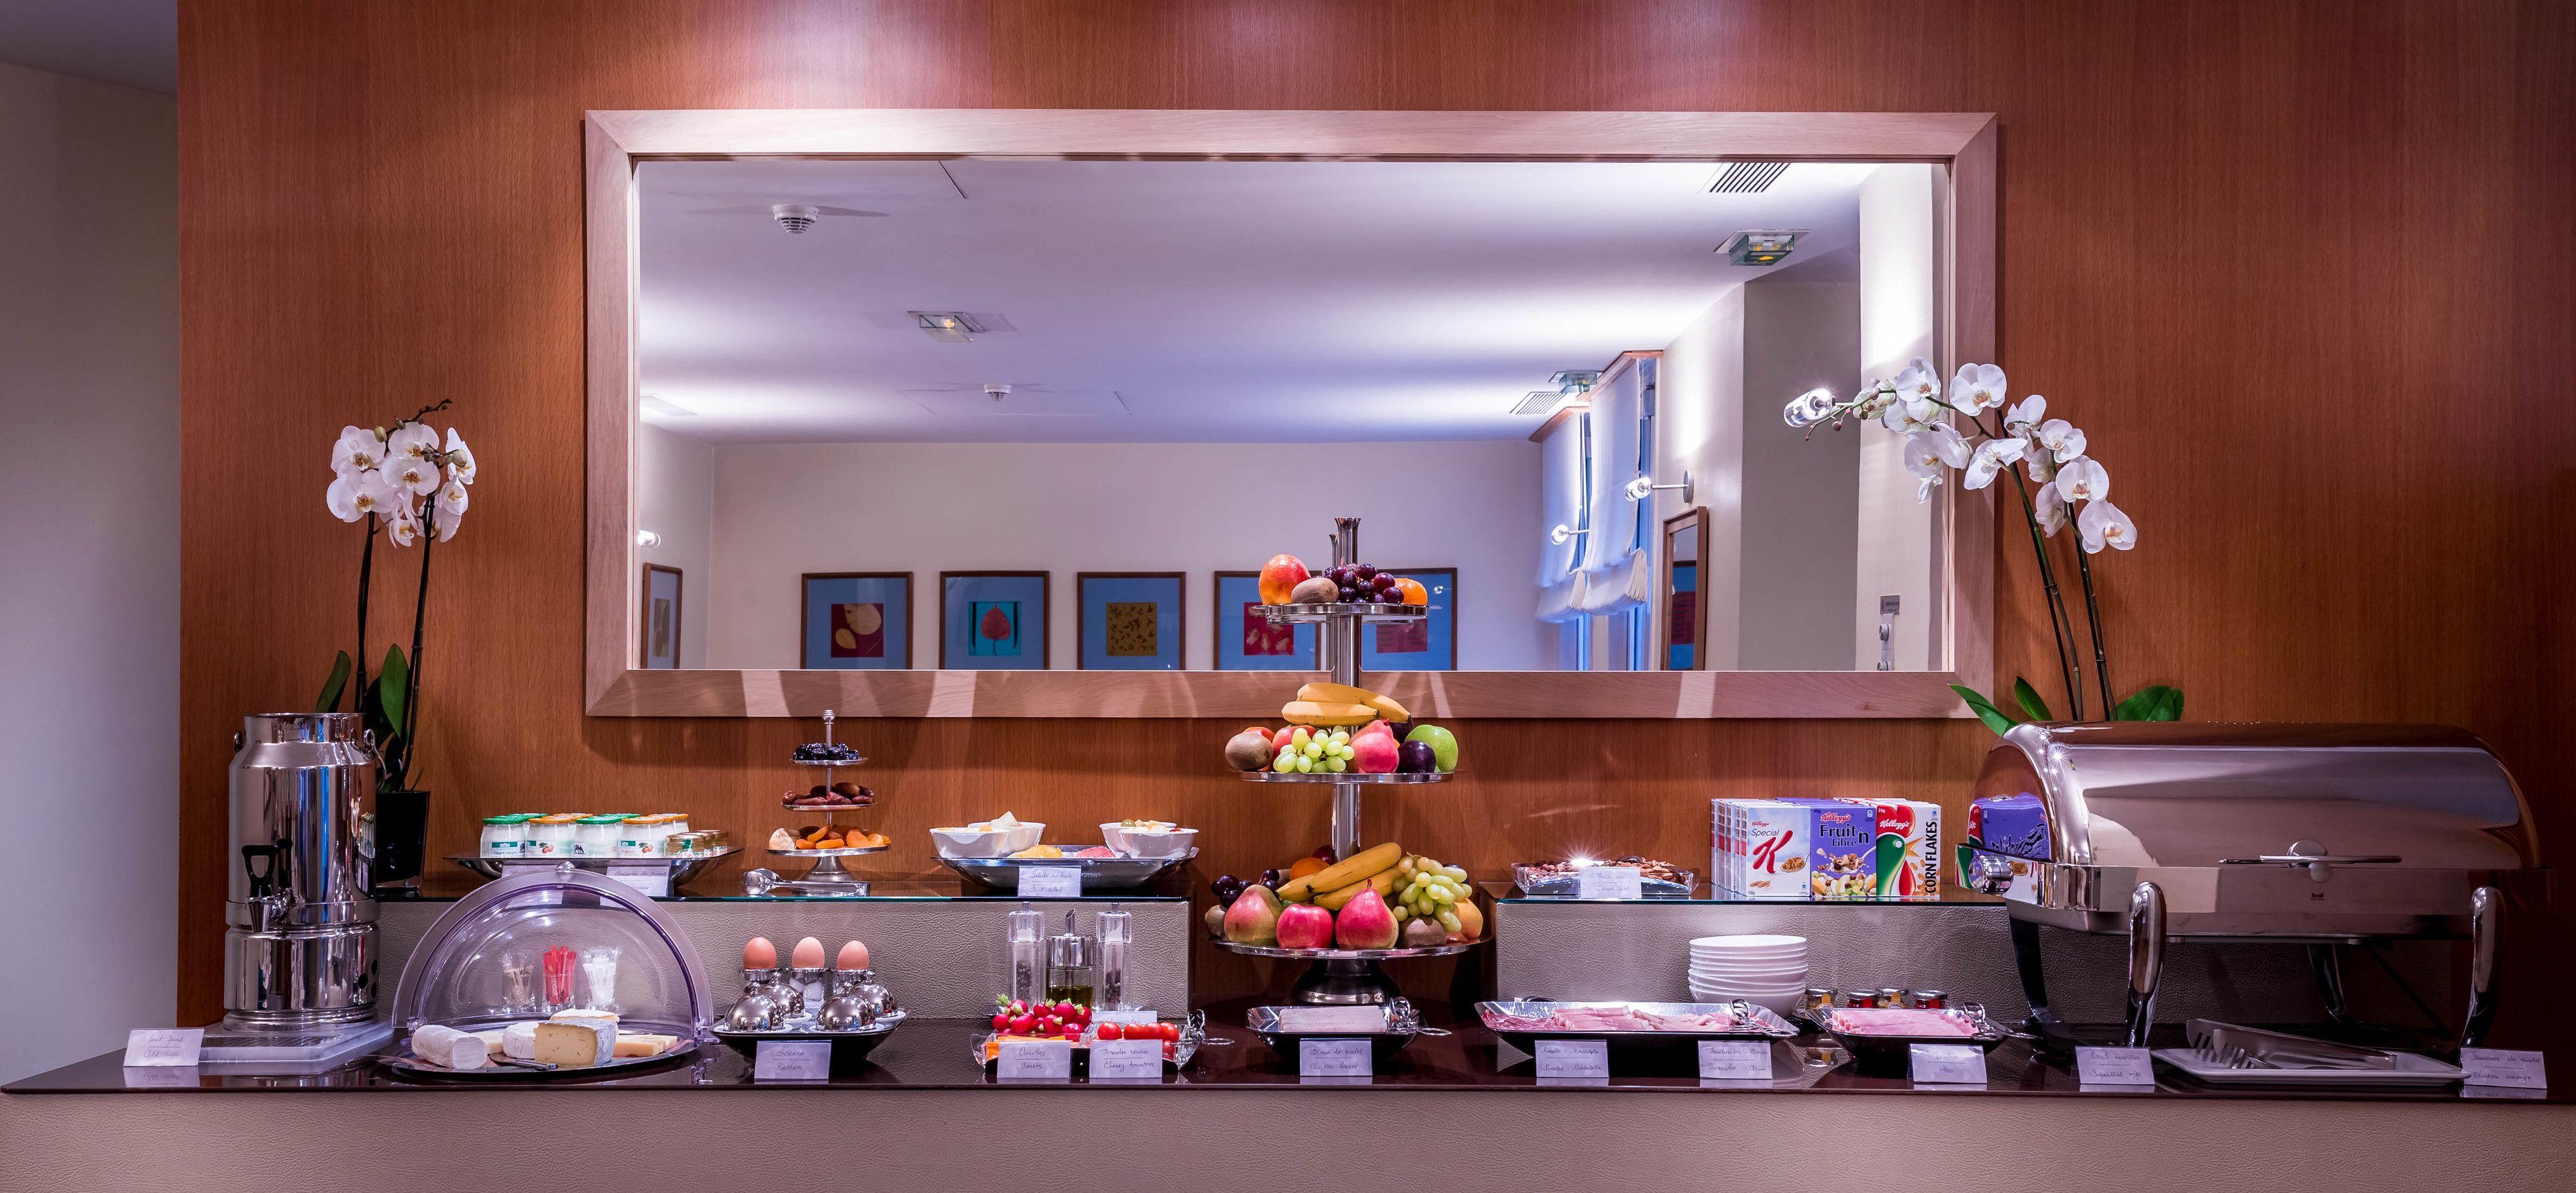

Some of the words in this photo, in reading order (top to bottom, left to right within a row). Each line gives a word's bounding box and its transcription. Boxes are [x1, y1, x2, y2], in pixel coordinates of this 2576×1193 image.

[1820, 811, 1851, 824] Kellogg's
[1879, 818, 1910, 830] Kellogg's
[1751, 828, 1780, 838] Special
[1820, 823, 1857, 838] Fruit
[1832, 838, 1857, 847] Fibre
[1925, 821, 1937, 861] FLAKES
[1752, 830, 1794, 874] K
[1925, 862, 1937, 894] CORN
